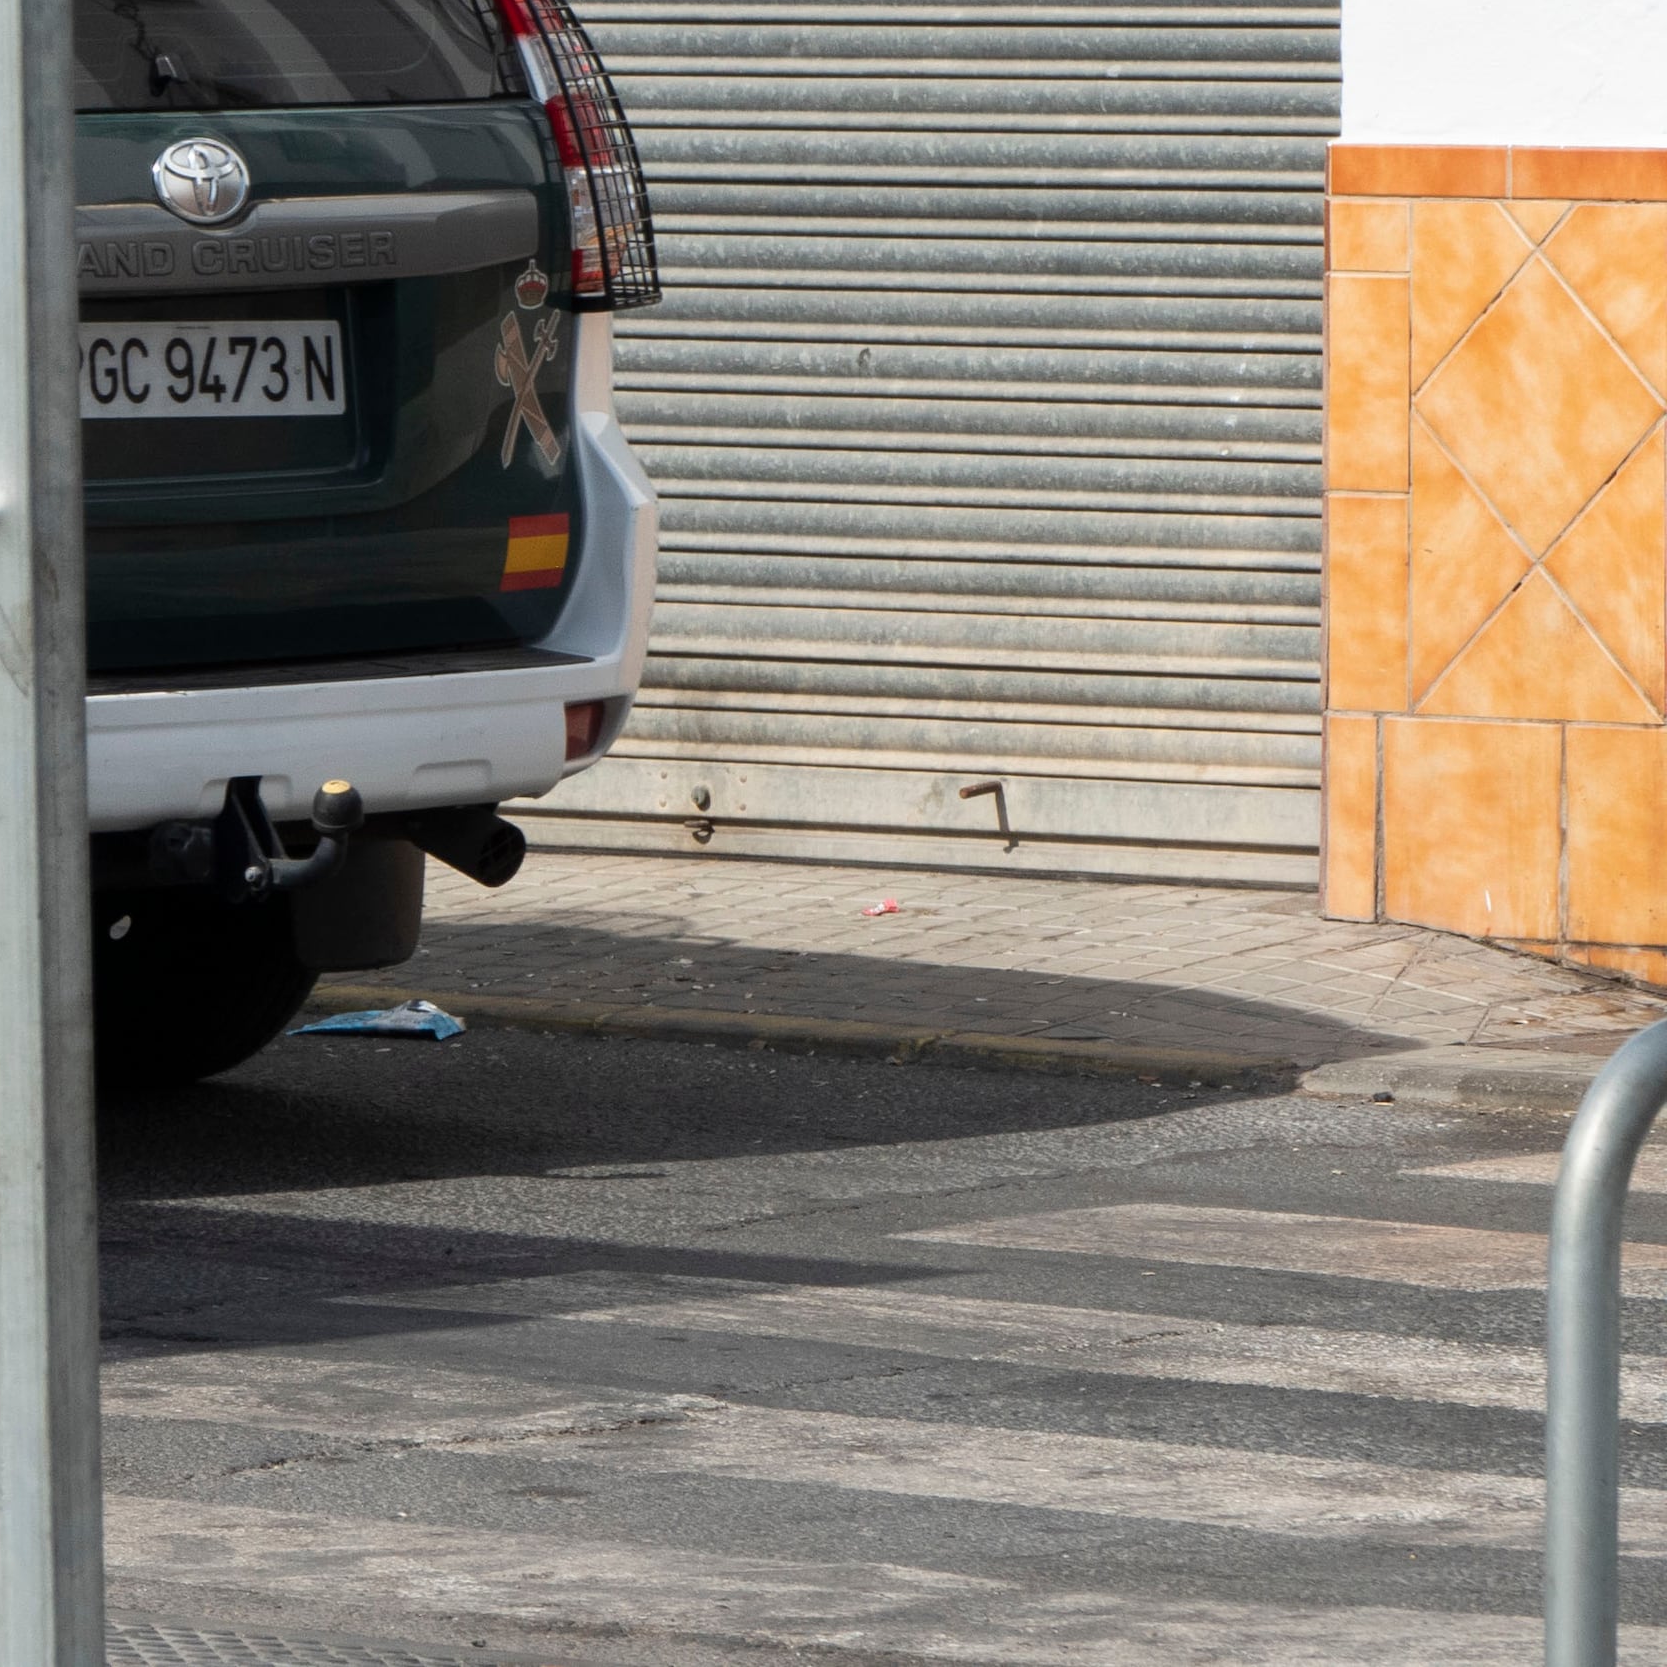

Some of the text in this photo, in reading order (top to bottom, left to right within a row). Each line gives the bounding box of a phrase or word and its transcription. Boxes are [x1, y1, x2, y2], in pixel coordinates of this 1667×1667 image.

[77, 230, 397, 278] AND CRUISER
[79, 335, 336, 404] GC 9473 N
